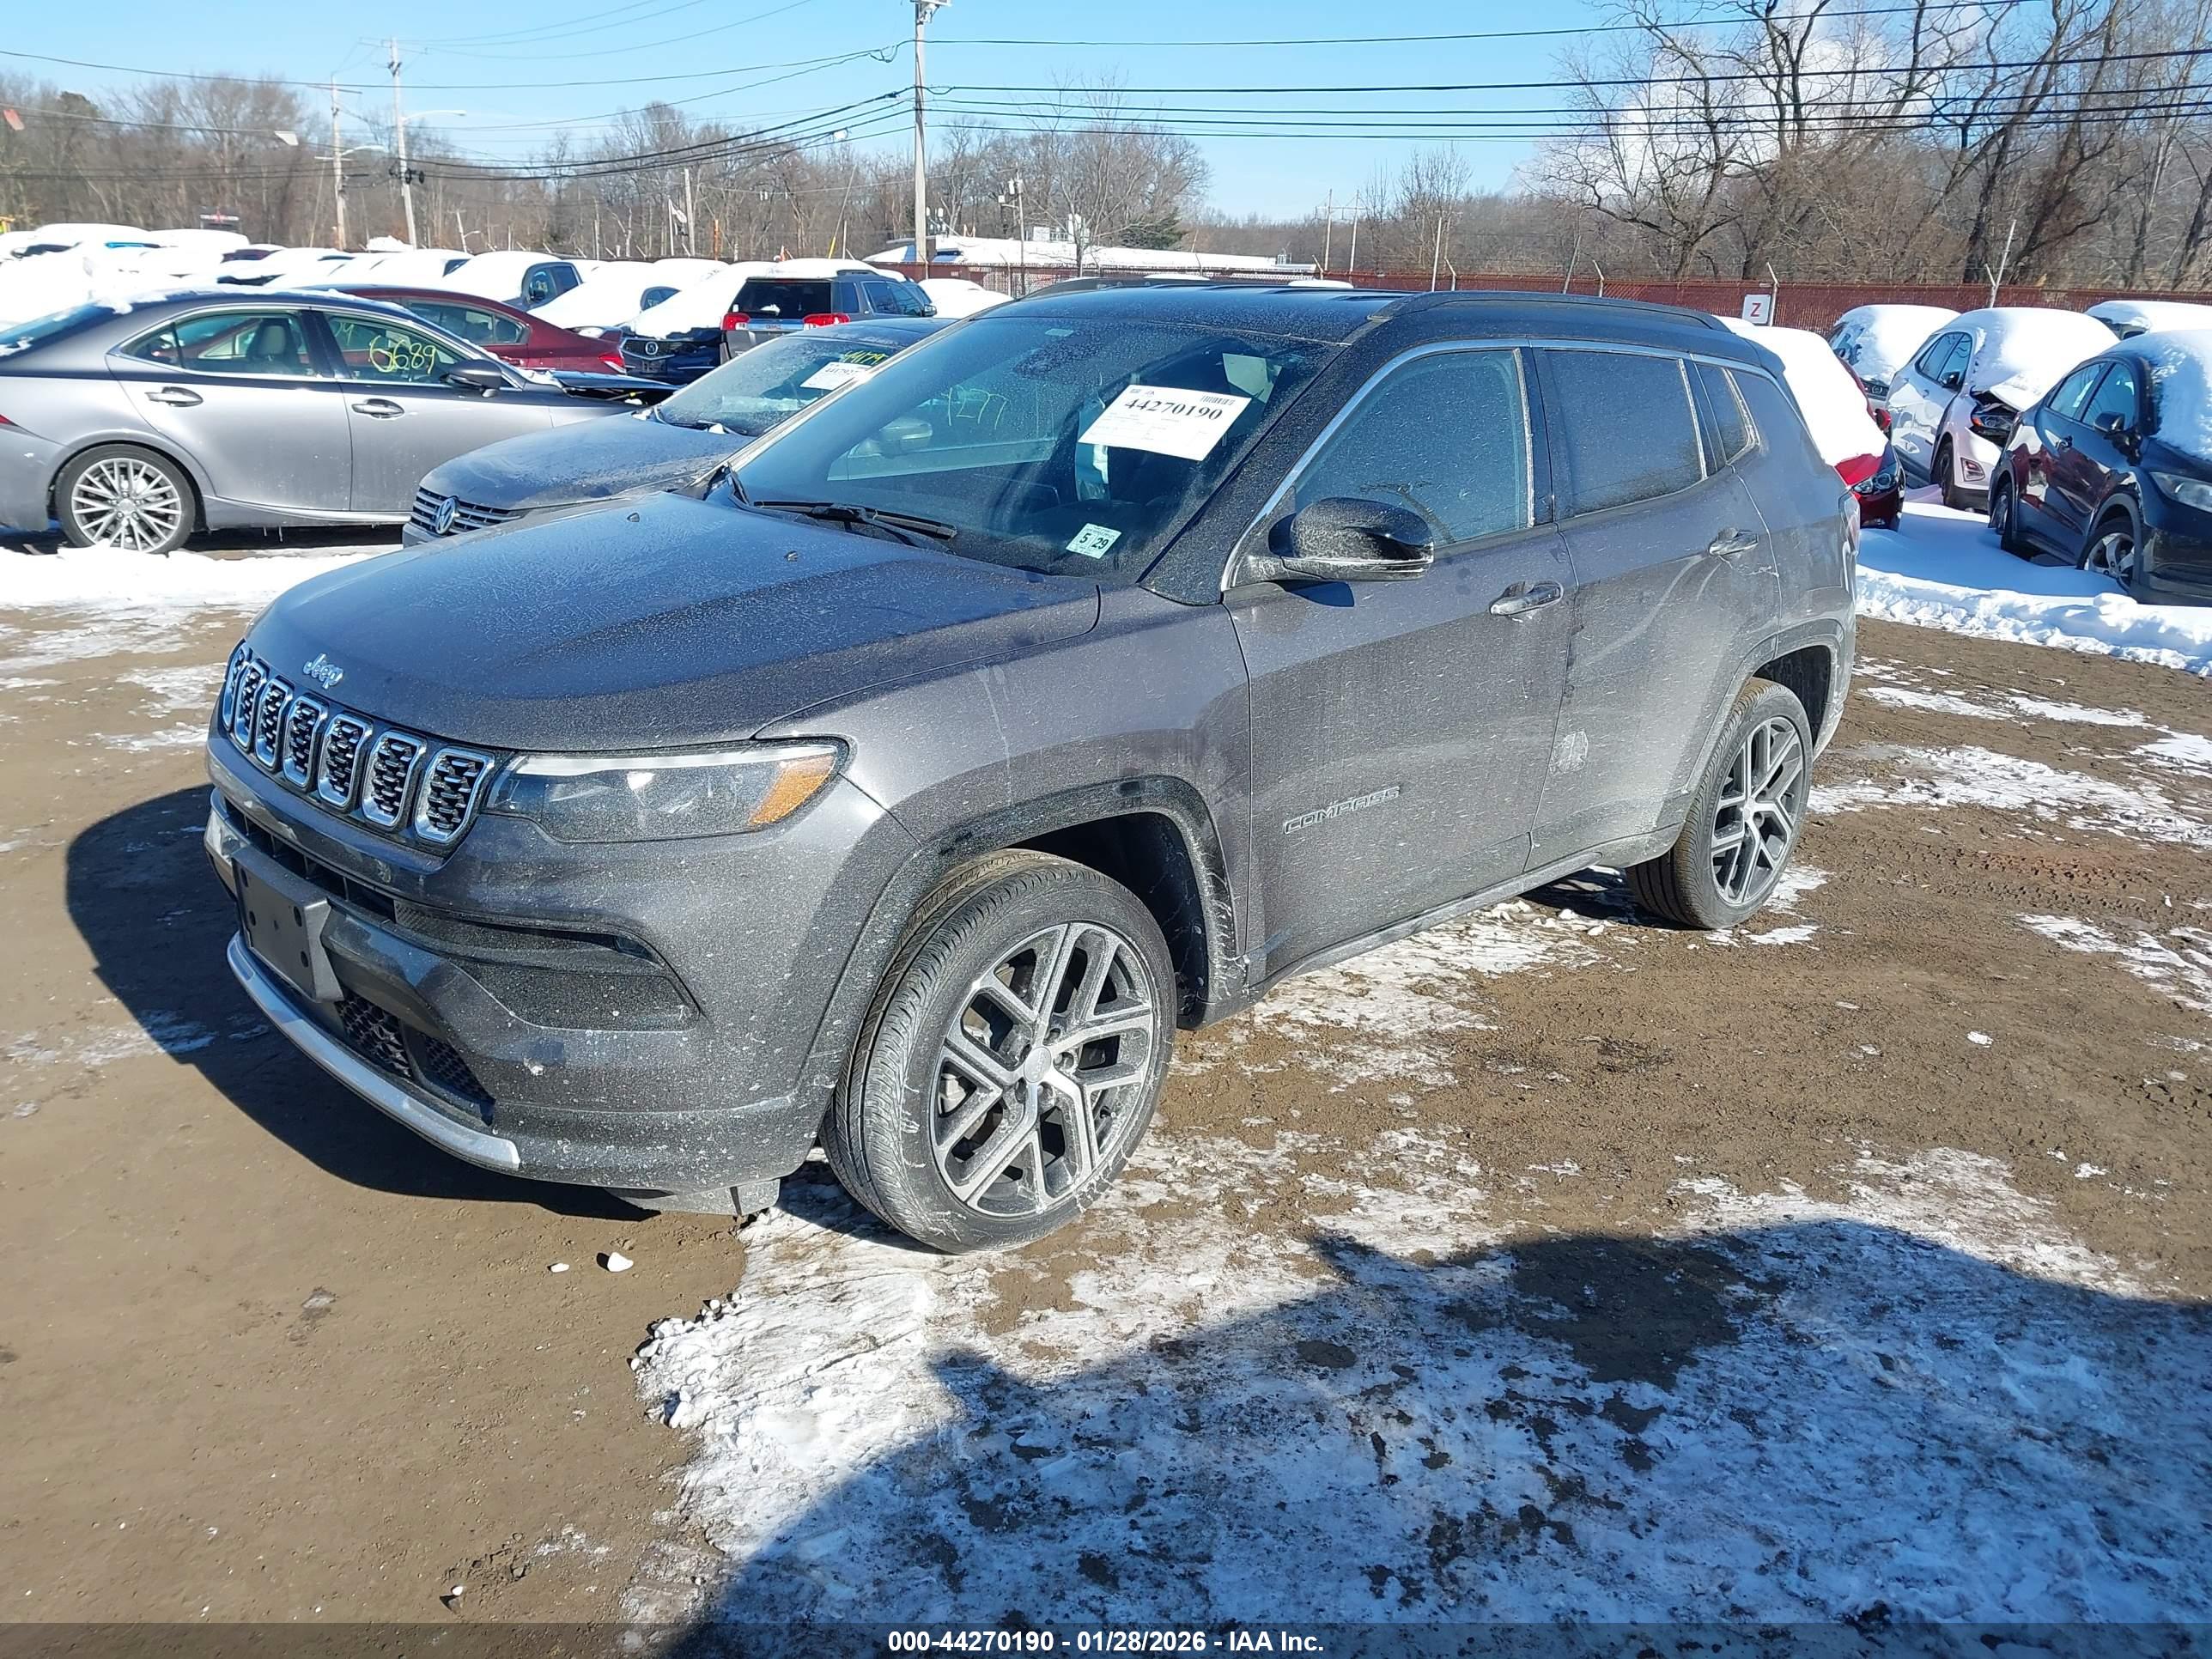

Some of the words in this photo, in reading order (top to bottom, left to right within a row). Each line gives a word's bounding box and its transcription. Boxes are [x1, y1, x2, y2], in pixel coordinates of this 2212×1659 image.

[1750, 302, 1761, 317] Z
[369, 335, 435, 374] 6689
[1124, 398, 1223, 421] 44270190
[1079, 532, 1091, 544] 5
[1091, 538, 1109, 550] 29
[303, 653, 343, 689] Jeep
[1283, 786, 1401, 835] COMPASS
